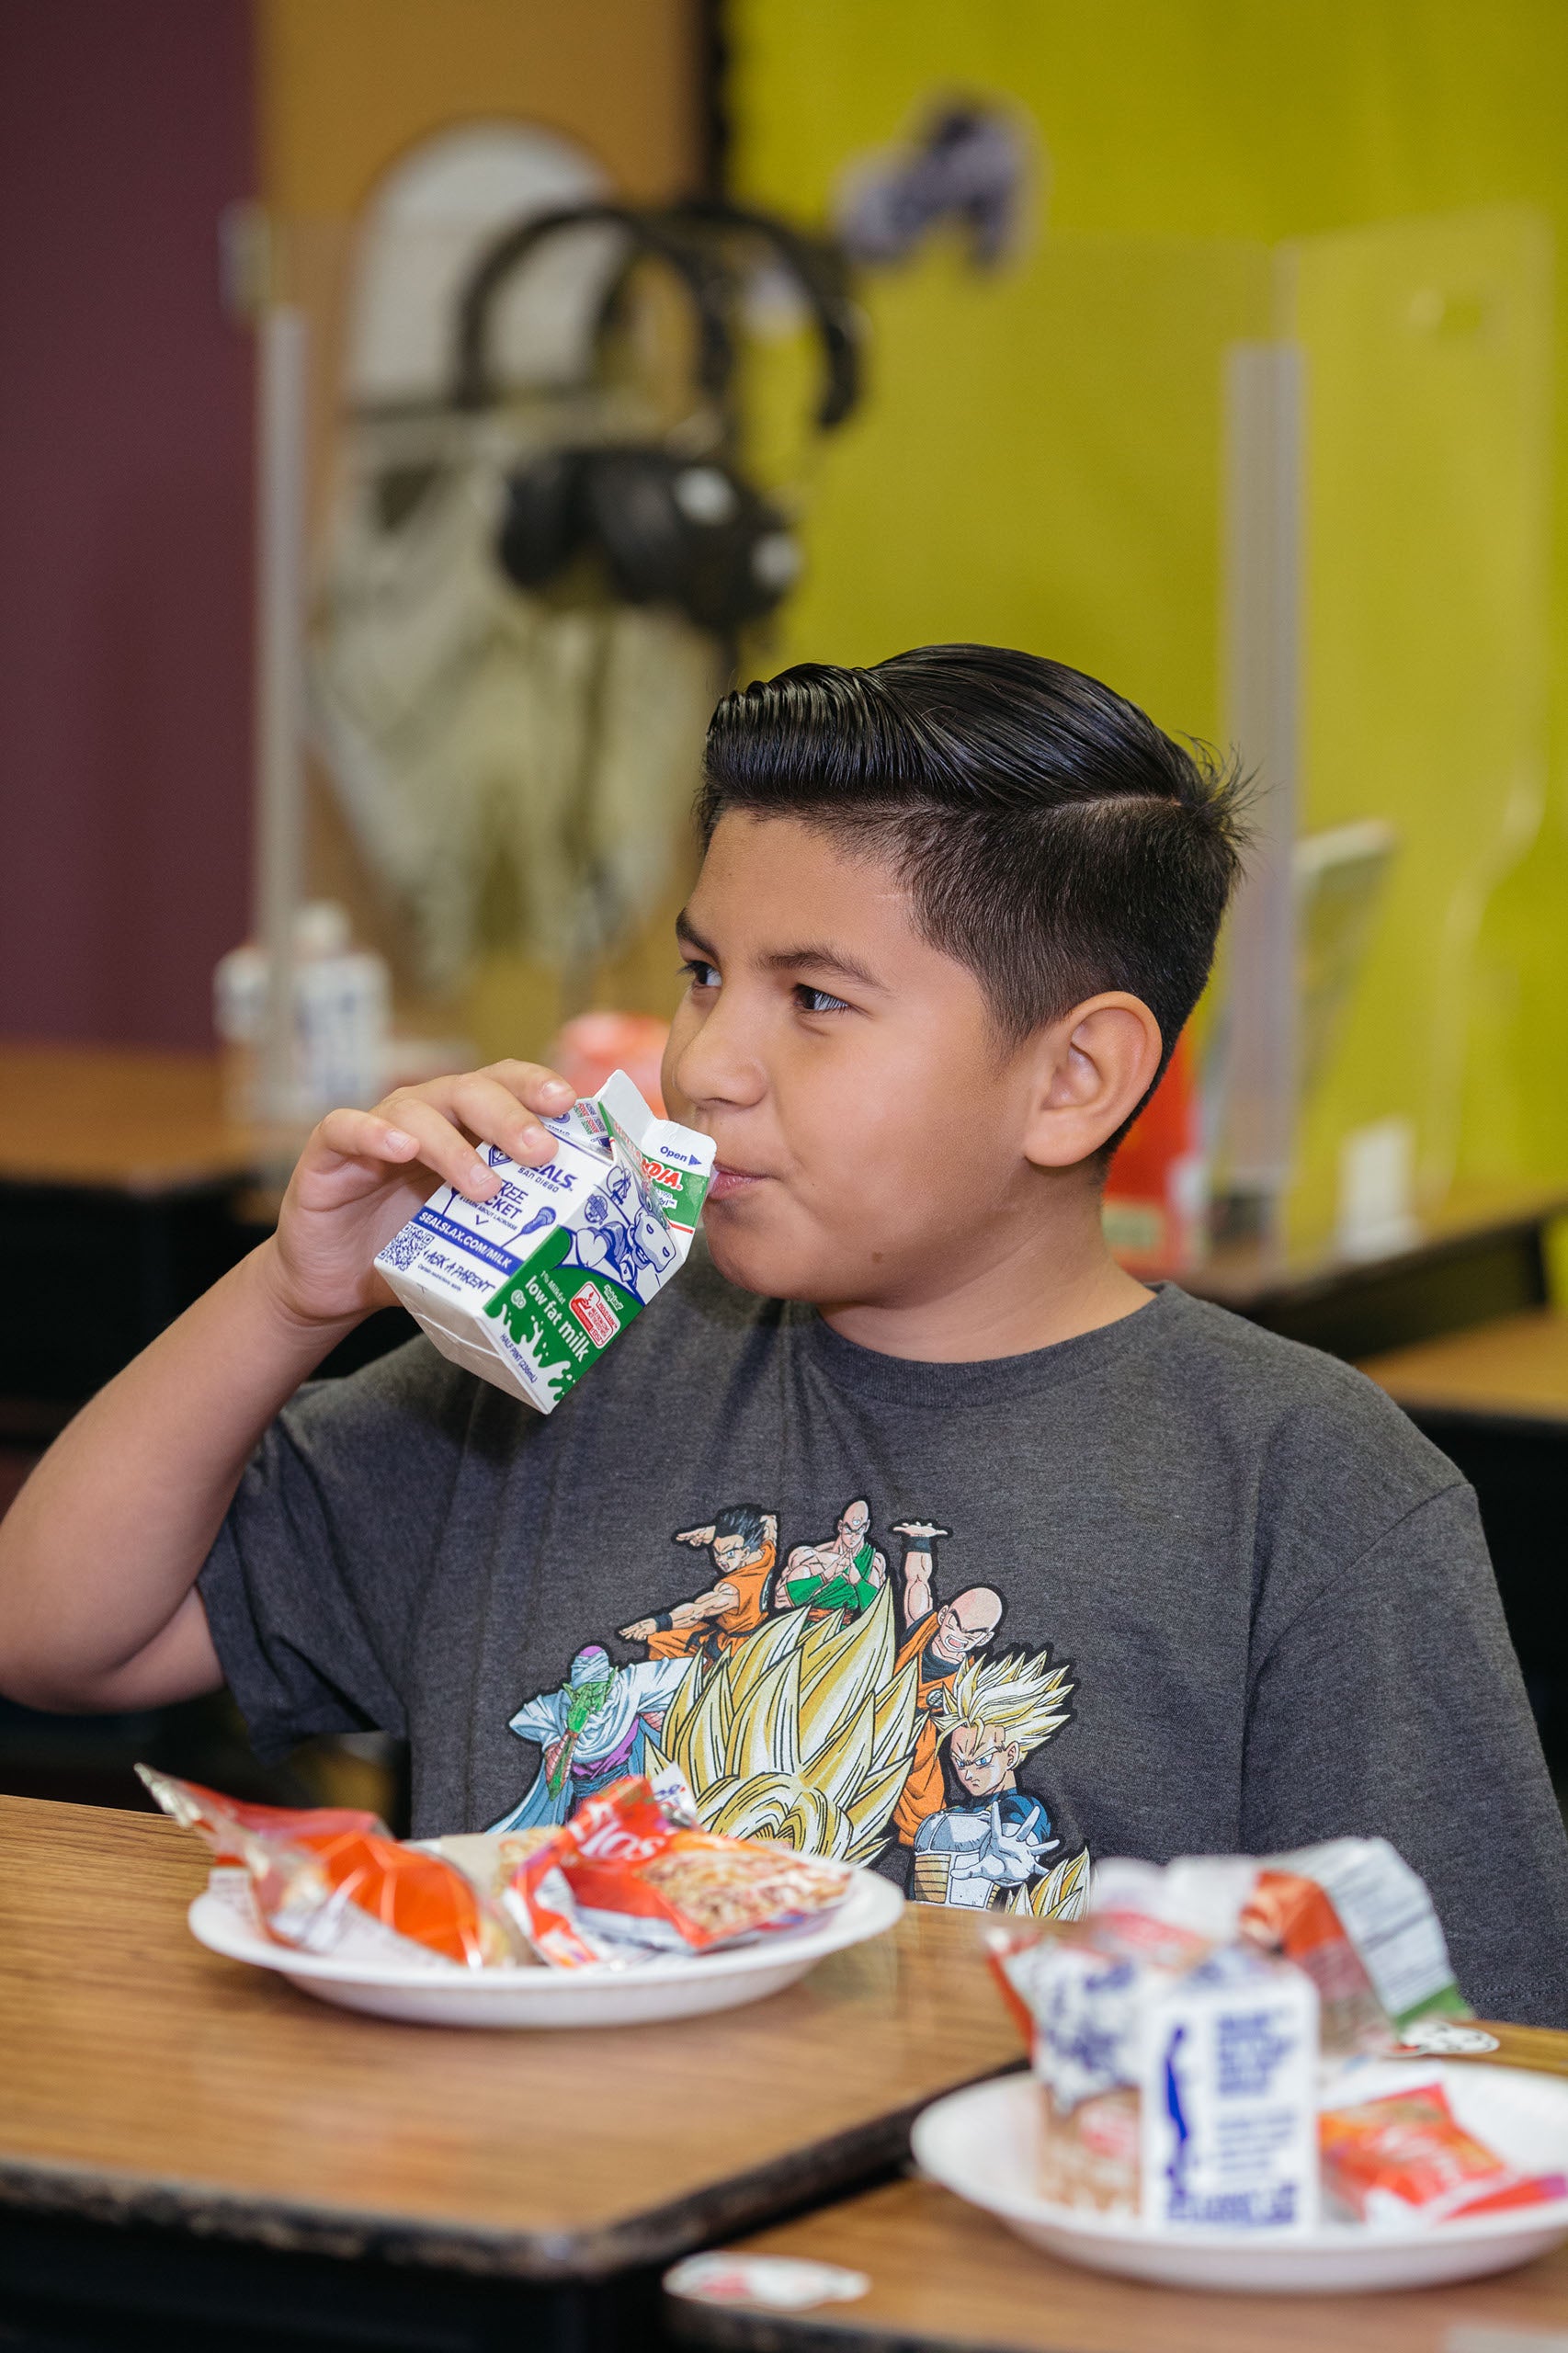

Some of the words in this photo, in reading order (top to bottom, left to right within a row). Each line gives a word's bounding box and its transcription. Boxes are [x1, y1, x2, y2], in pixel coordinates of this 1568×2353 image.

[660, 1145, 687, 1162] Open
[517, 1166, 535, 1179] SAN
[535, 1176, 560, 1193] DIEGO
[529, 1163, 578, 1189] ALS
[500, 1178, 528, 1205] REE
[484, 1194, 523, 1220] CKET
[418, 1211, 513, 1269] SEALSLAX.COM/MILK
[425, 1251, 449, 1268] ASK
[446, 1262, 457, 1274] A
[450, 1266, 496, 1292] PARENT
[525, 1275, 548, 1306] low
[543, 1300, 562, 1325] fat
[558, 1320, 590, 1363] milk
